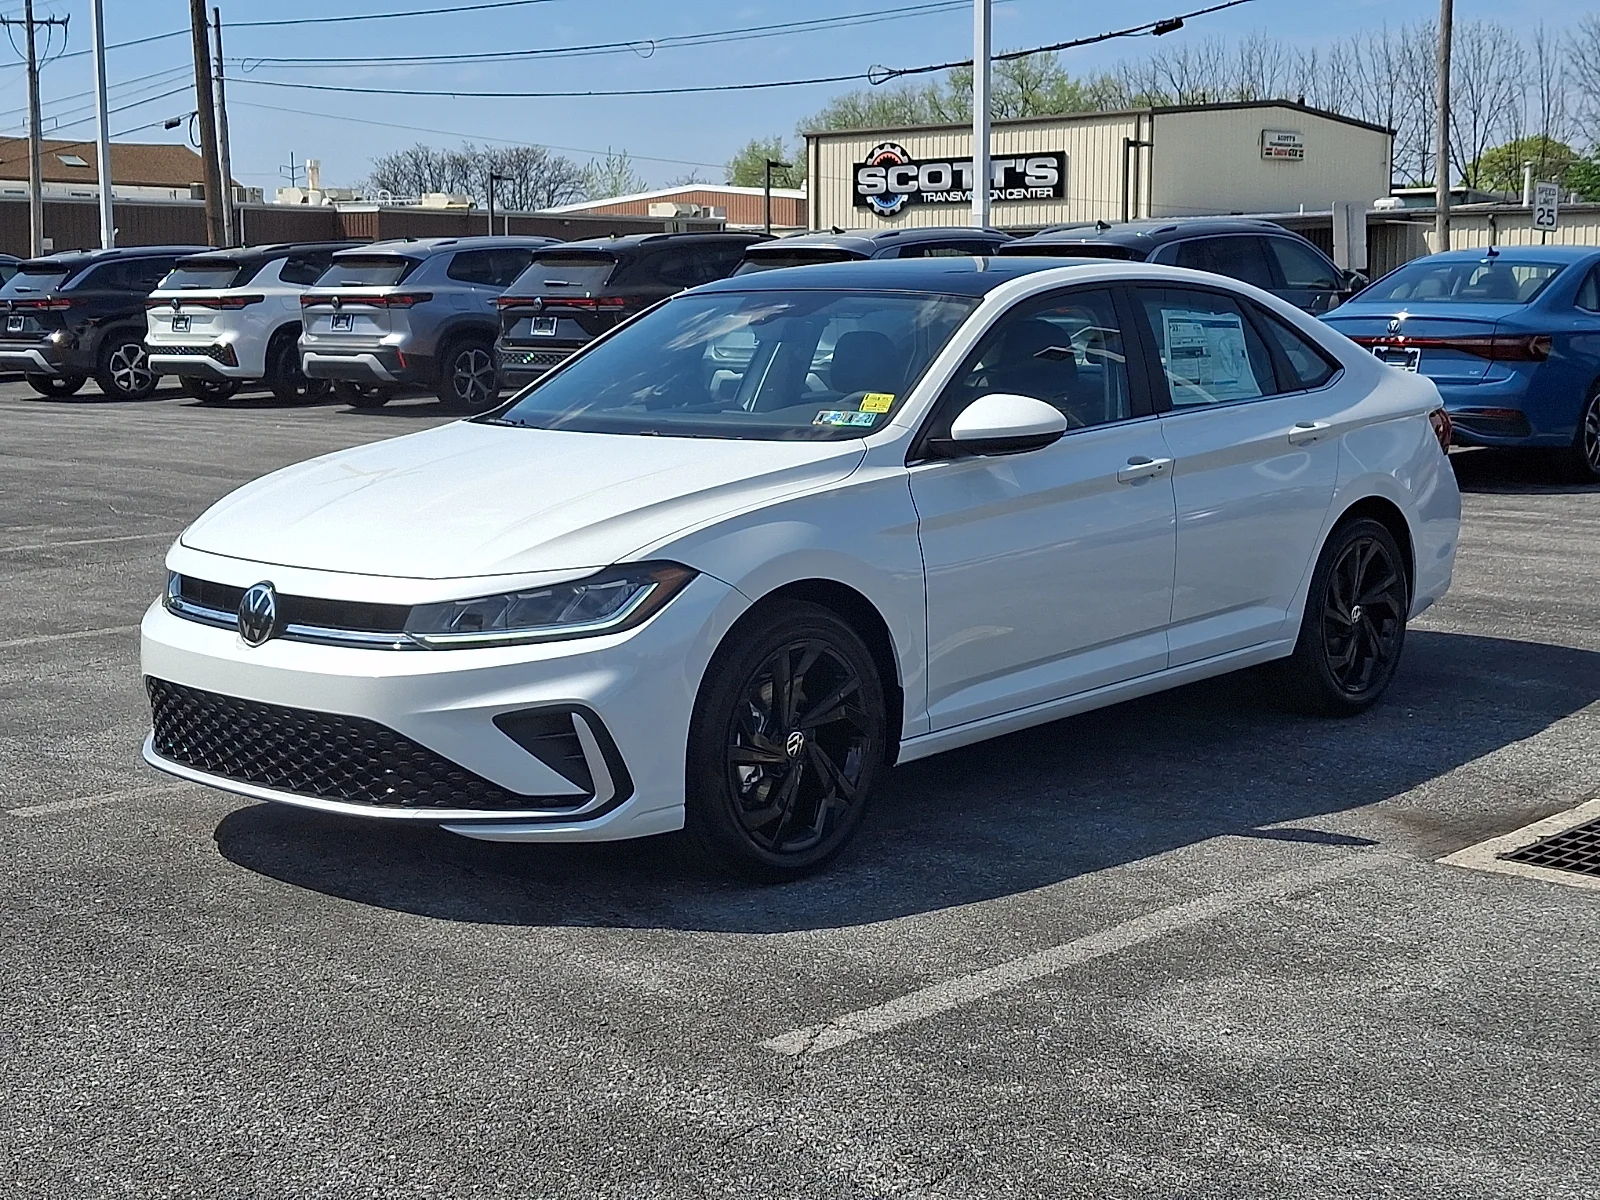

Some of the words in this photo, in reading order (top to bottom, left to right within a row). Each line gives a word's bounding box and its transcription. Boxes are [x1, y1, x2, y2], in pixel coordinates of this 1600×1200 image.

[857, 157, 1058, 195] SCOTT'S
[1006, 187, 1053, 200] CENTER
[1538, 187, 1556, 196] SPEED
[1539, 197, 1554, 206] LIMIT
[1537, 207, 1555, 226] 25
